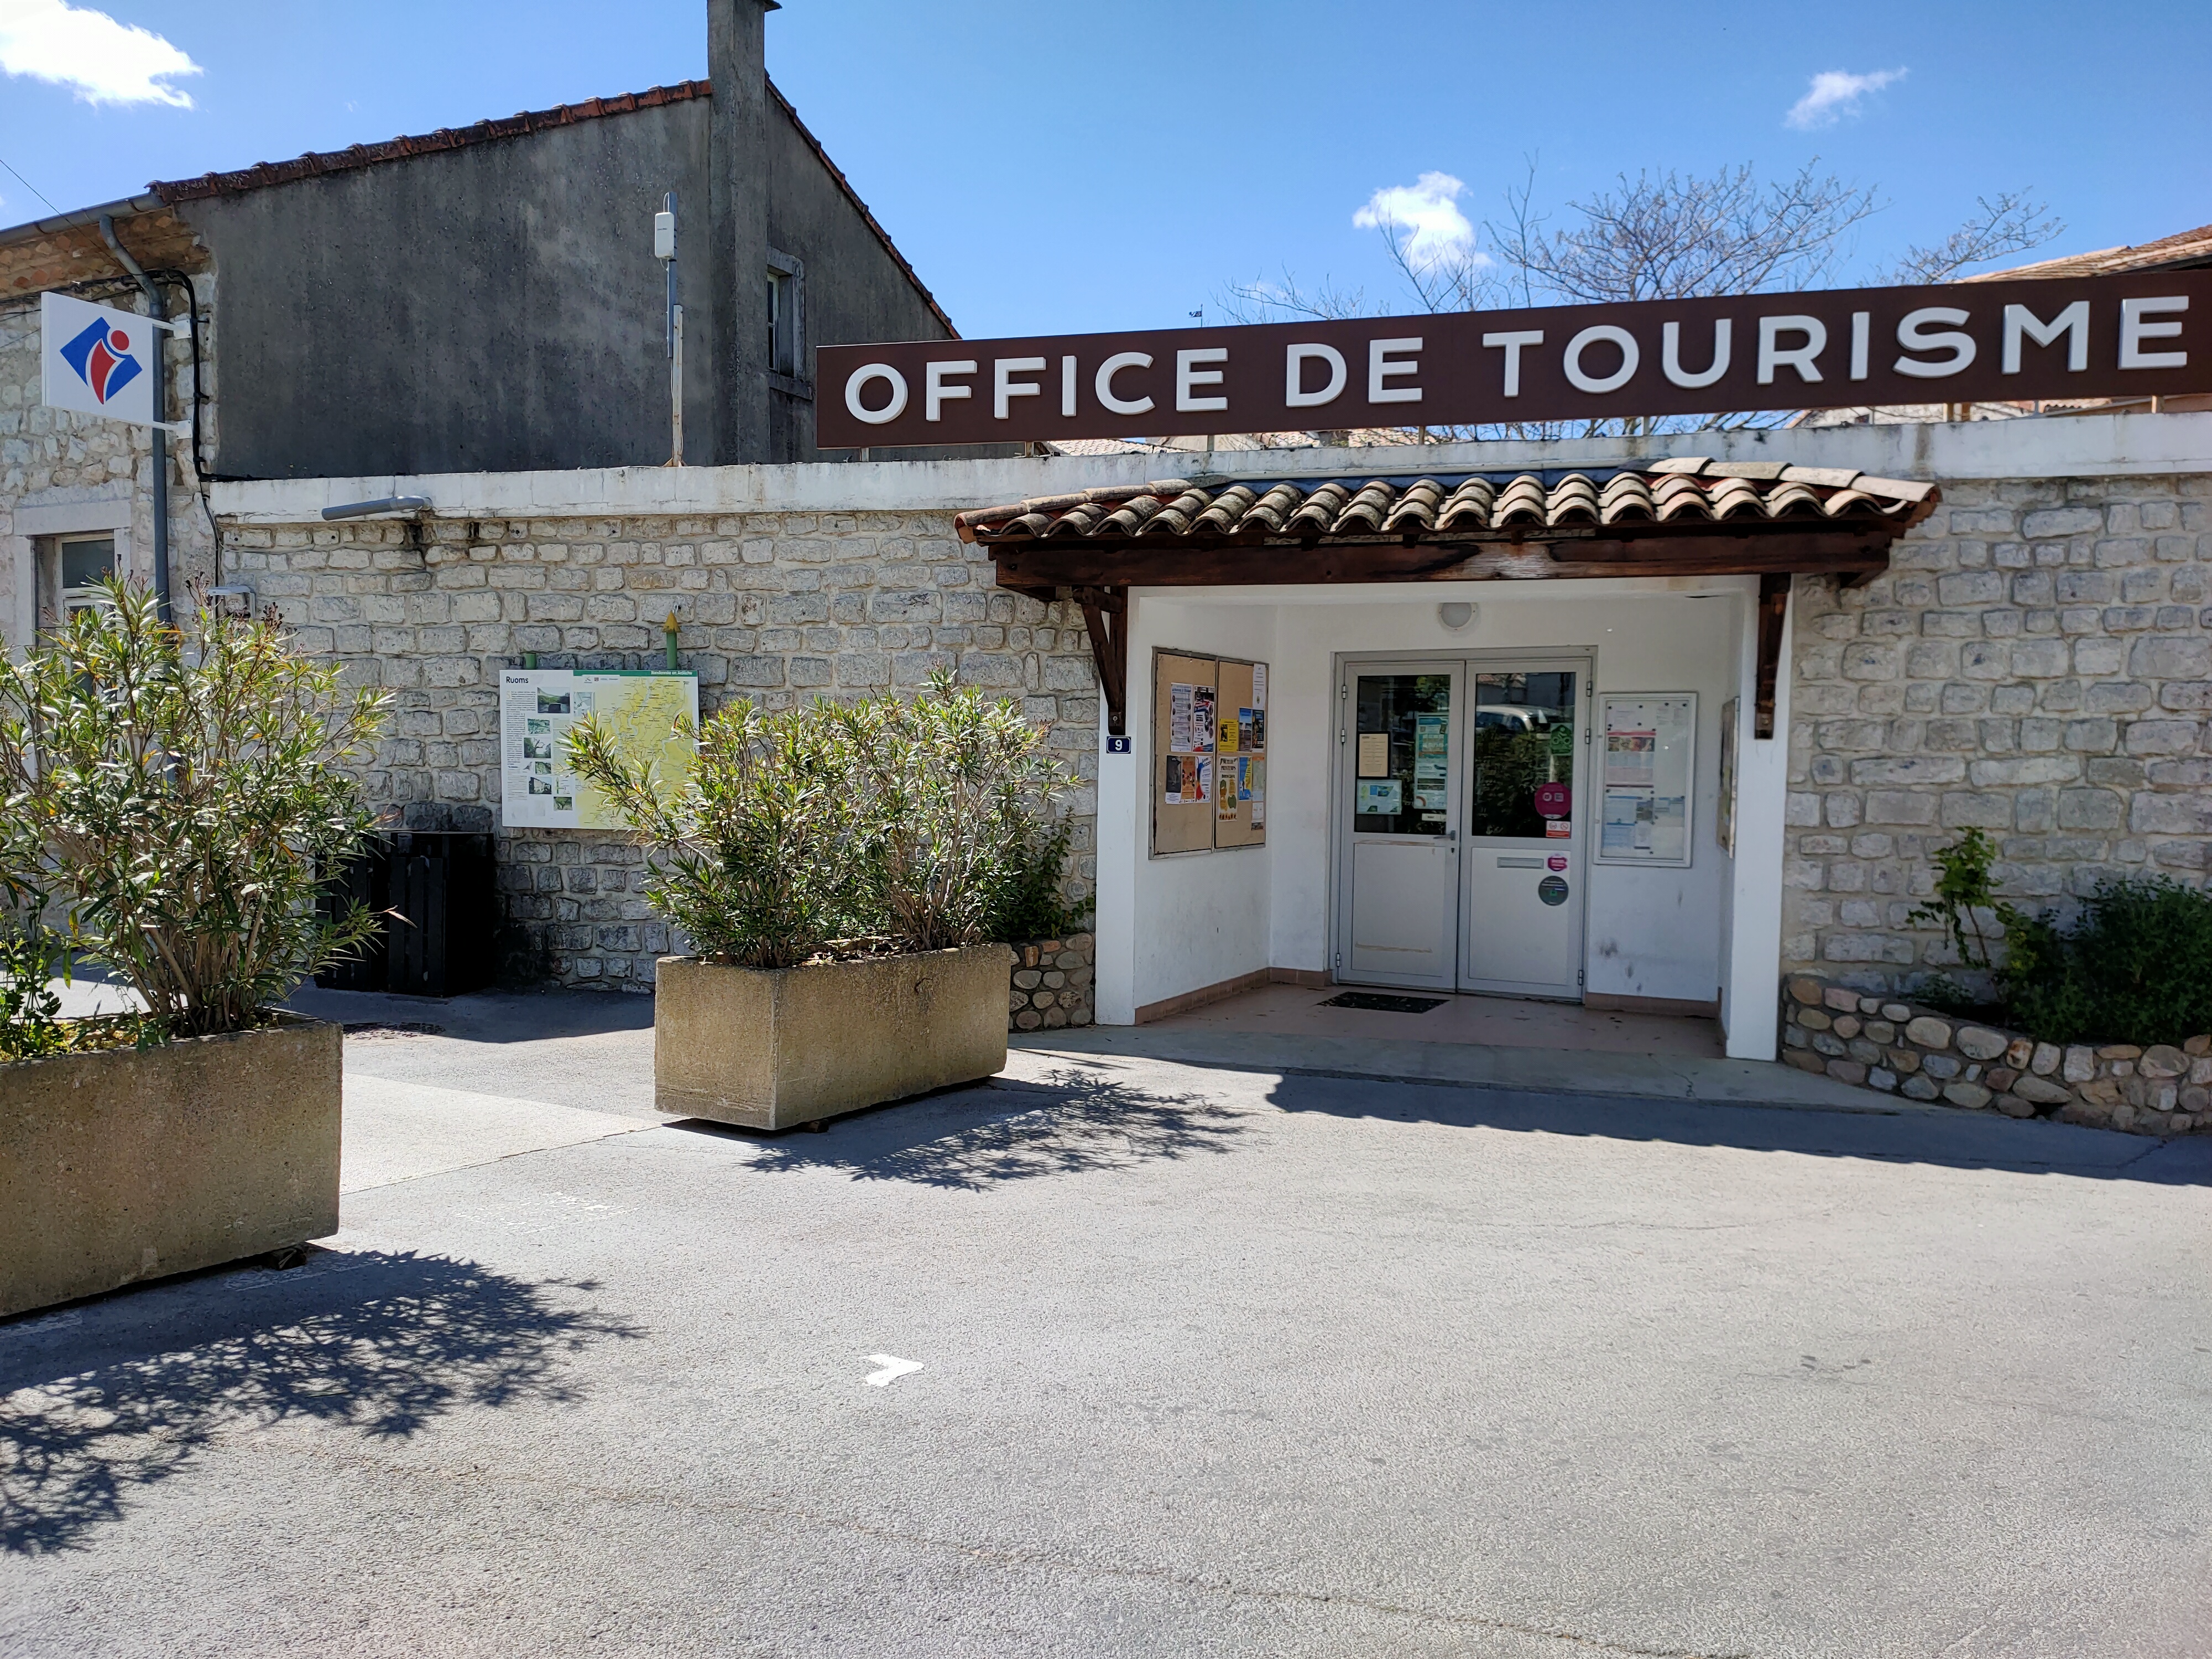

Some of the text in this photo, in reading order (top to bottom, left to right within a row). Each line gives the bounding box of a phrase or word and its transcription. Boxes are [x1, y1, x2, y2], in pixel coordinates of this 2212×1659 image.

[845, 295, 2189, 425] OFFICE DE TOURISME
[1115, 739, 1123, 751] 9
